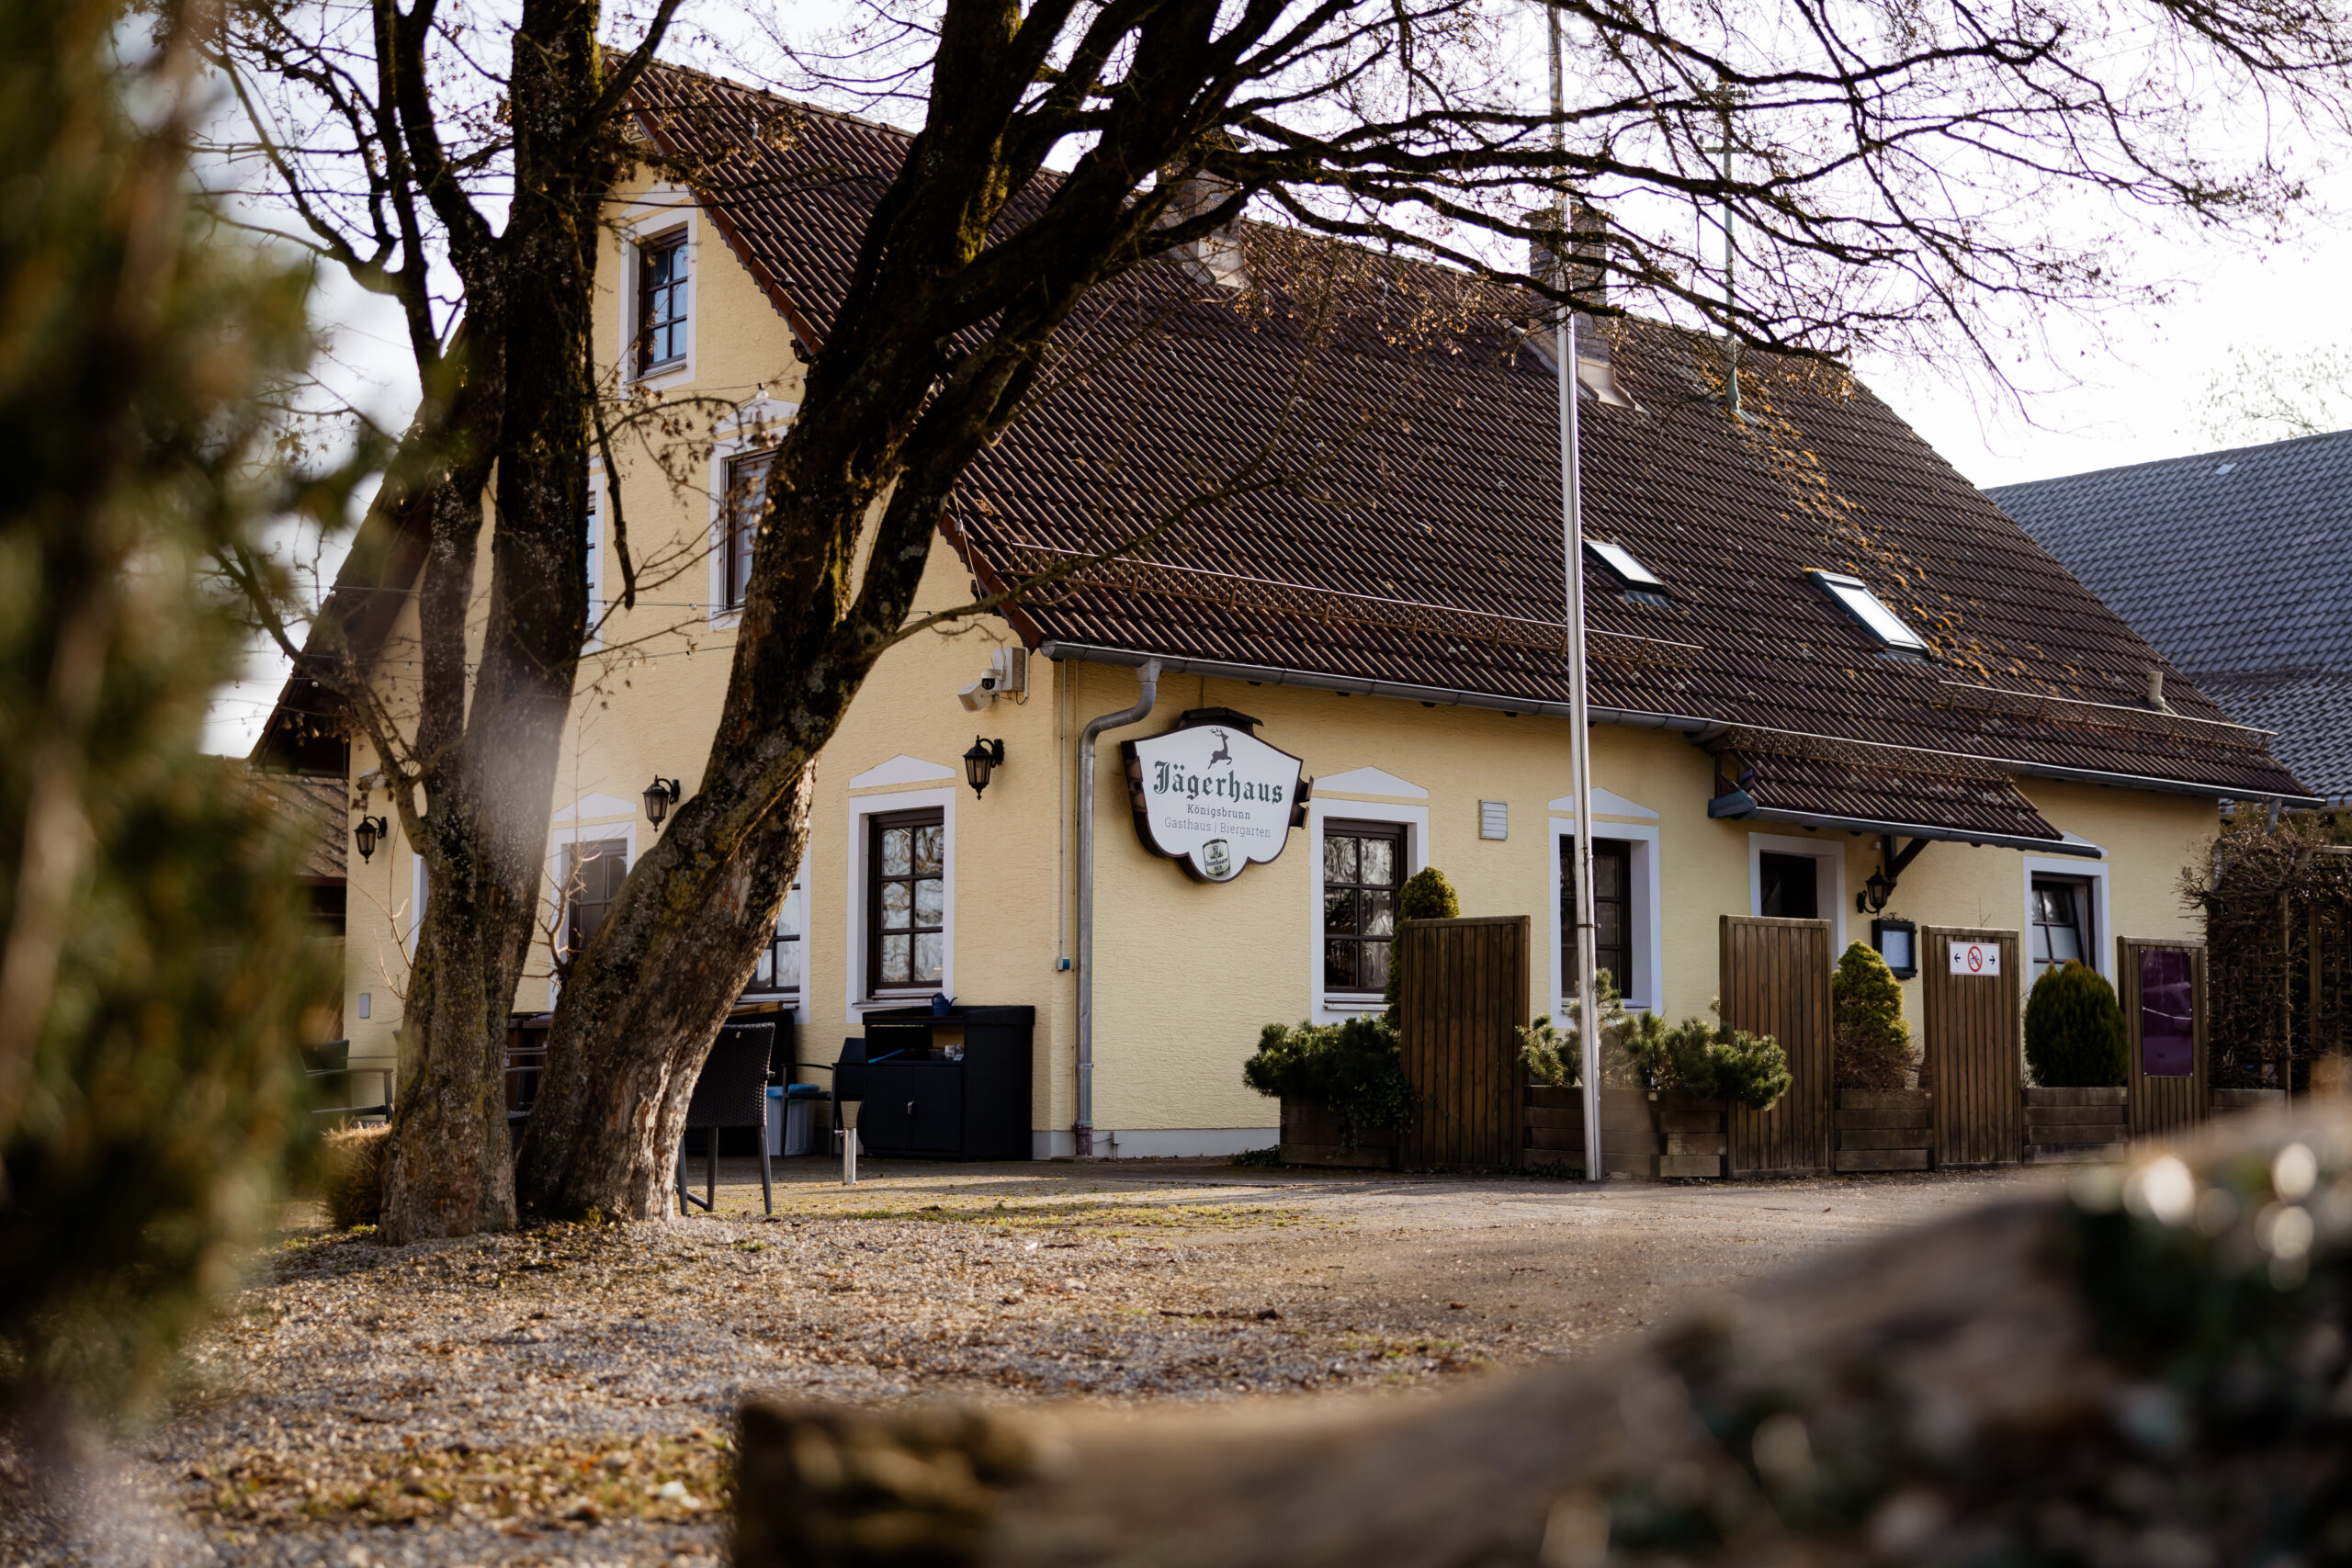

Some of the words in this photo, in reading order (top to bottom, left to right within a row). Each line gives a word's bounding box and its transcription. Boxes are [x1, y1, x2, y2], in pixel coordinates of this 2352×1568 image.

[1153, 761, 1283, 805] Jägerhaus
[1187, 803, 1250, 819] Königsbrunn
[1164, 817, 1211, 831] Gasthaus
[1220, 822, 1271, 838] Biergarten
